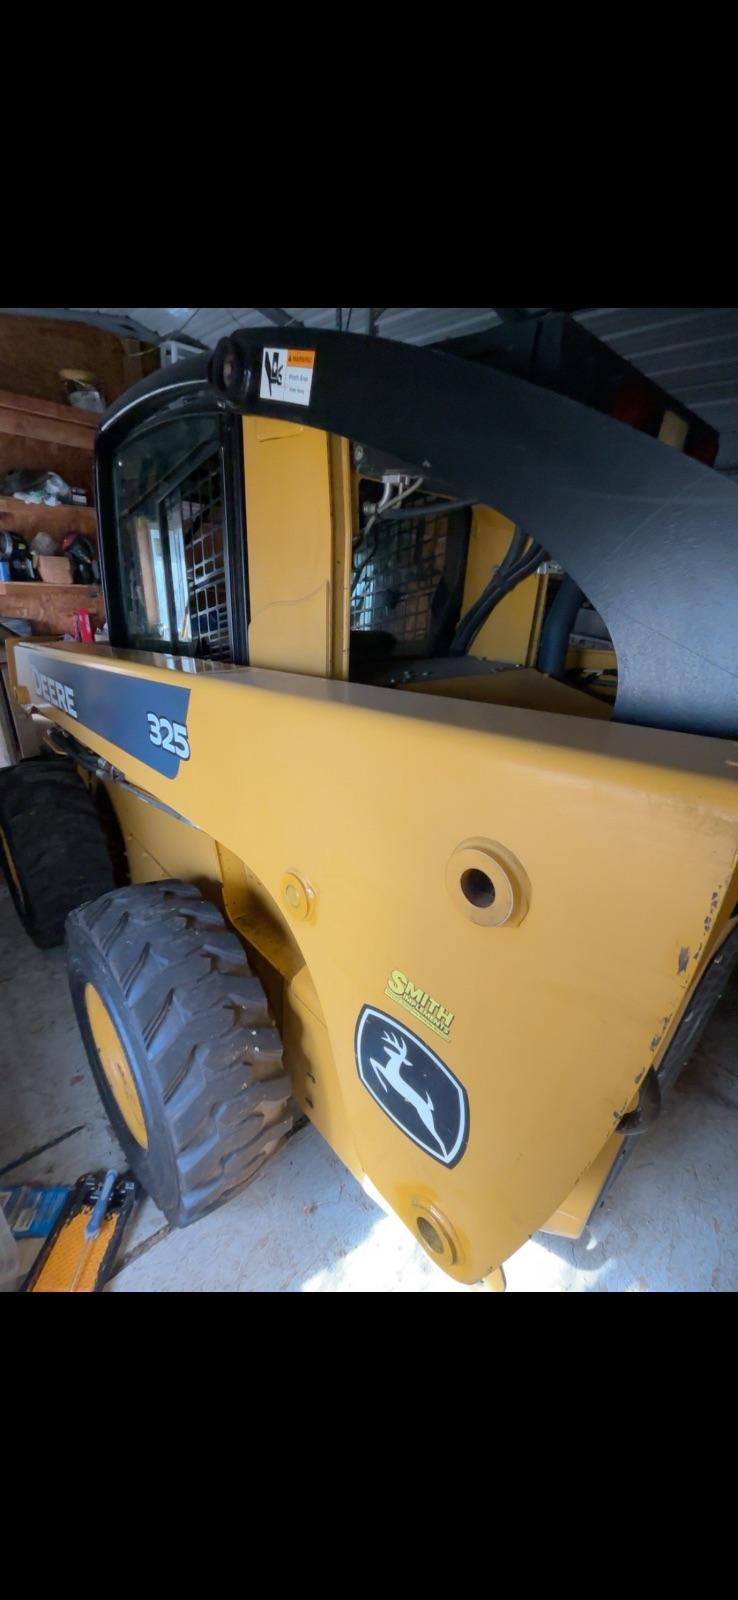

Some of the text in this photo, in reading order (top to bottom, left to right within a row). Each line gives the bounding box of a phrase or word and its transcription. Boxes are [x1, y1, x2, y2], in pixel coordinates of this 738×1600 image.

[31, 667, 78, 718] DEERE
[146, 711, 190, 760] 325
[387, 969, 455, 1028] SMITH
